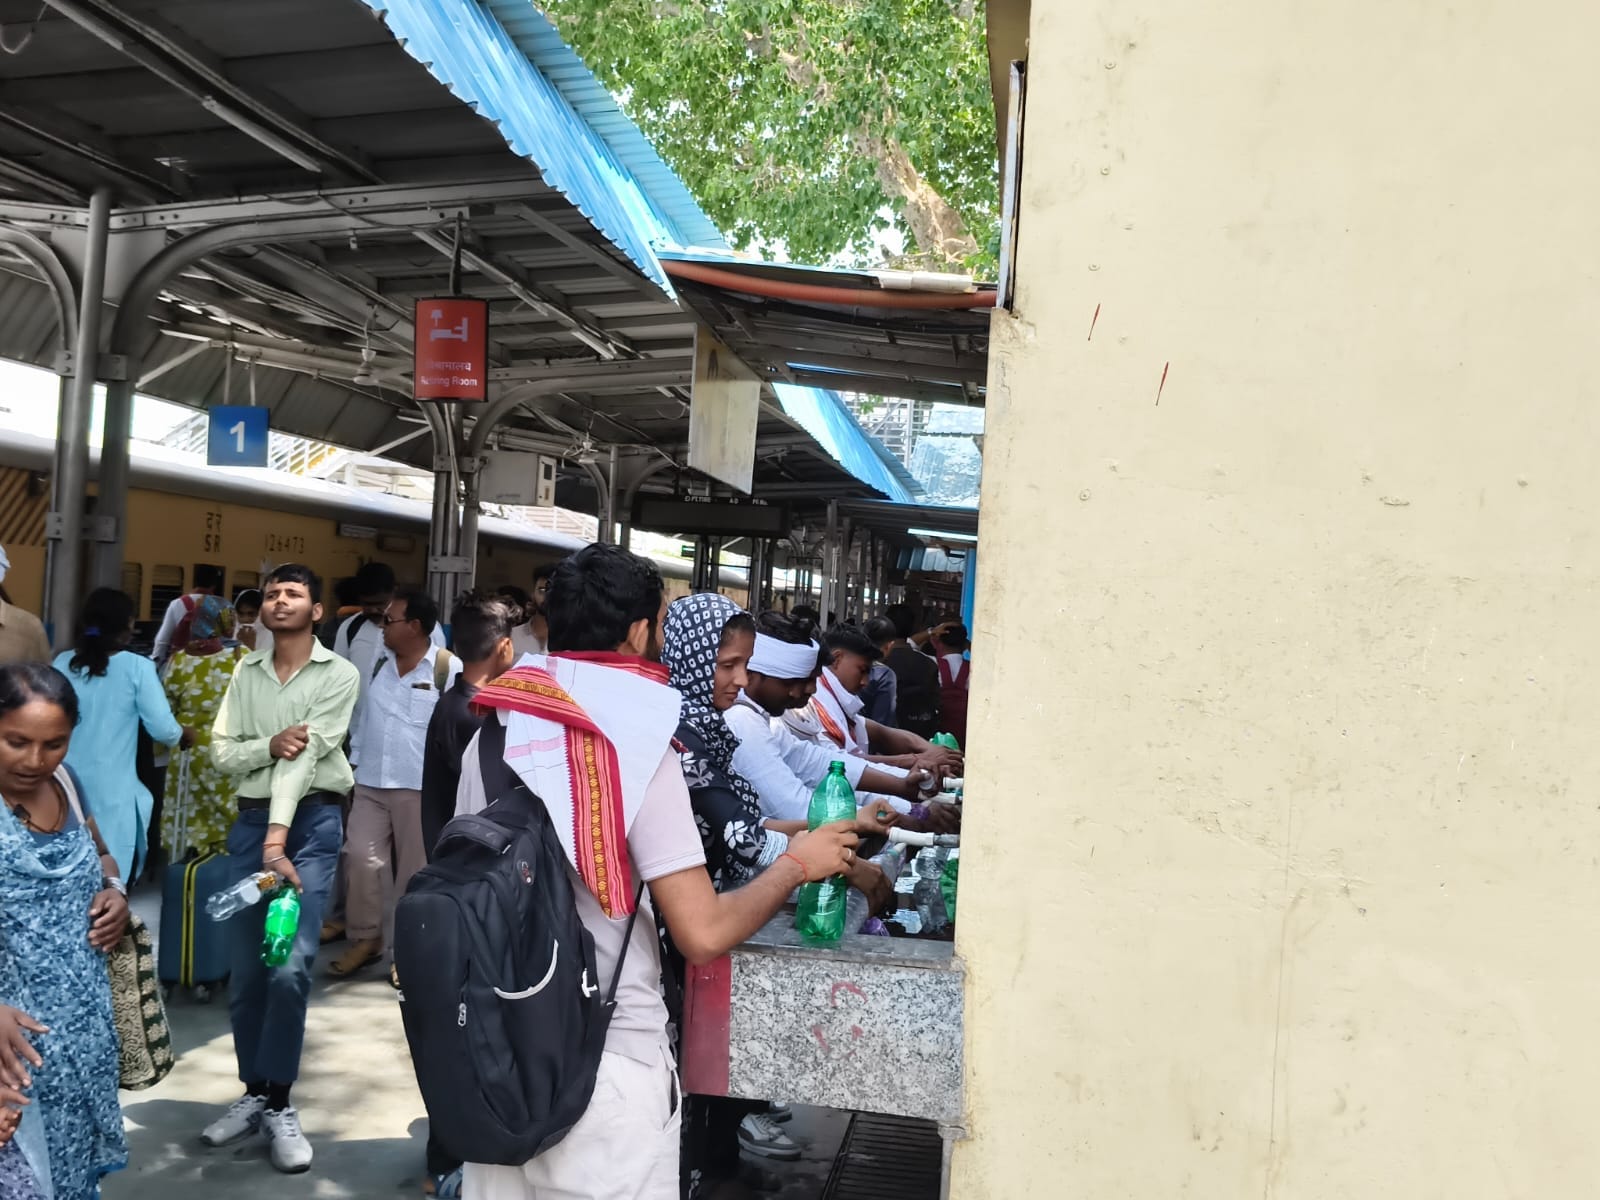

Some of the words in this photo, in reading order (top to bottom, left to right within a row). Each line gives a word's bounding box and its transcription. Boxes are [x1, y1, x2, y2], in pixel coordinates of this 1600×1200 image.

[452, 376, 478, 387] Room
[230, 421, 245, 452] 1
[204, 533, 221, 552] SR
